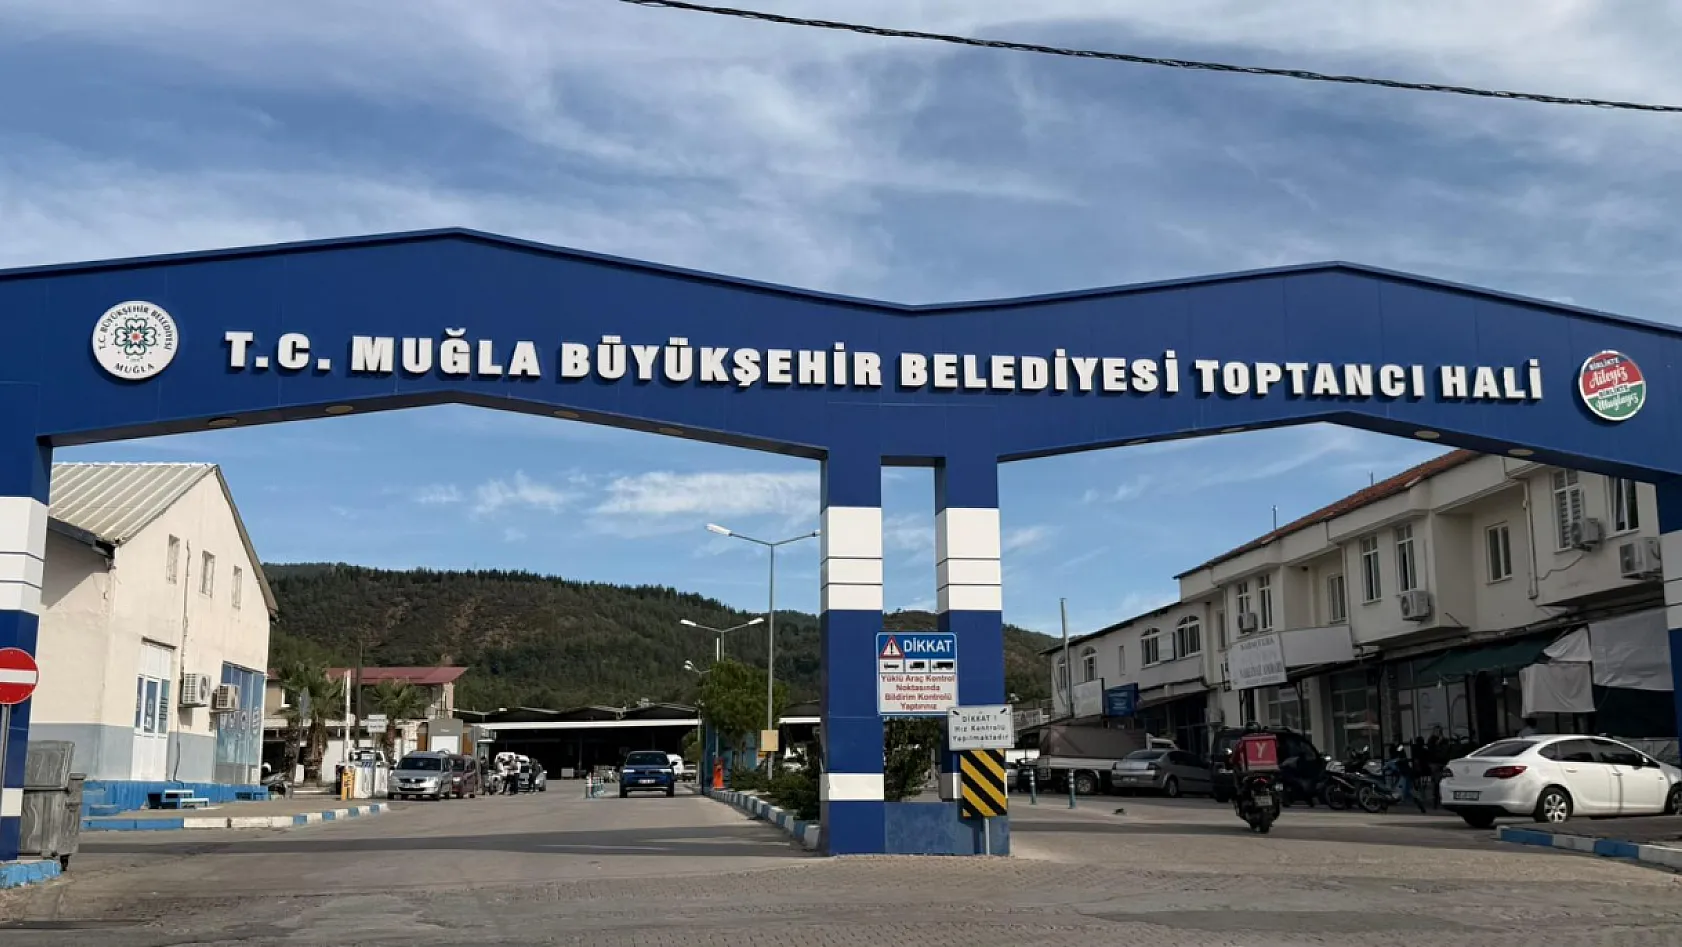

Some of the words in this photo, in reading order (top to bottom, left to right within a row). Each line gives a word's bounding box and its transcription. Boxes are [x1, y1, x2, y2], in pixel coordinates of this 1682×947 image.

[225, 331, 331, 370] T.C.
[350, 327, 541, 377] MUĞLA
[561, 334, 883, 388] BÜYÜKŞEHİR
[901, 348, 1179, 393] BELEDİYESİ
[1195, 359, 1426, 398] TOPTANCI
[1441, 358, 1543, 399] HALİ
[114, 362, 155, 374] MUĞLA
[903, 637, 953, 653] DİKKAT
[881, 674, 904, 682] Yüklü
[905, 674, 925, 683] Araç
[926, 674, 955, 682] Kontrol
[896, 684, 941, 692] Noktasında
[917, 692, 953, 701] Kontrolü
[962, 714, 990, 722] DİKKAT
